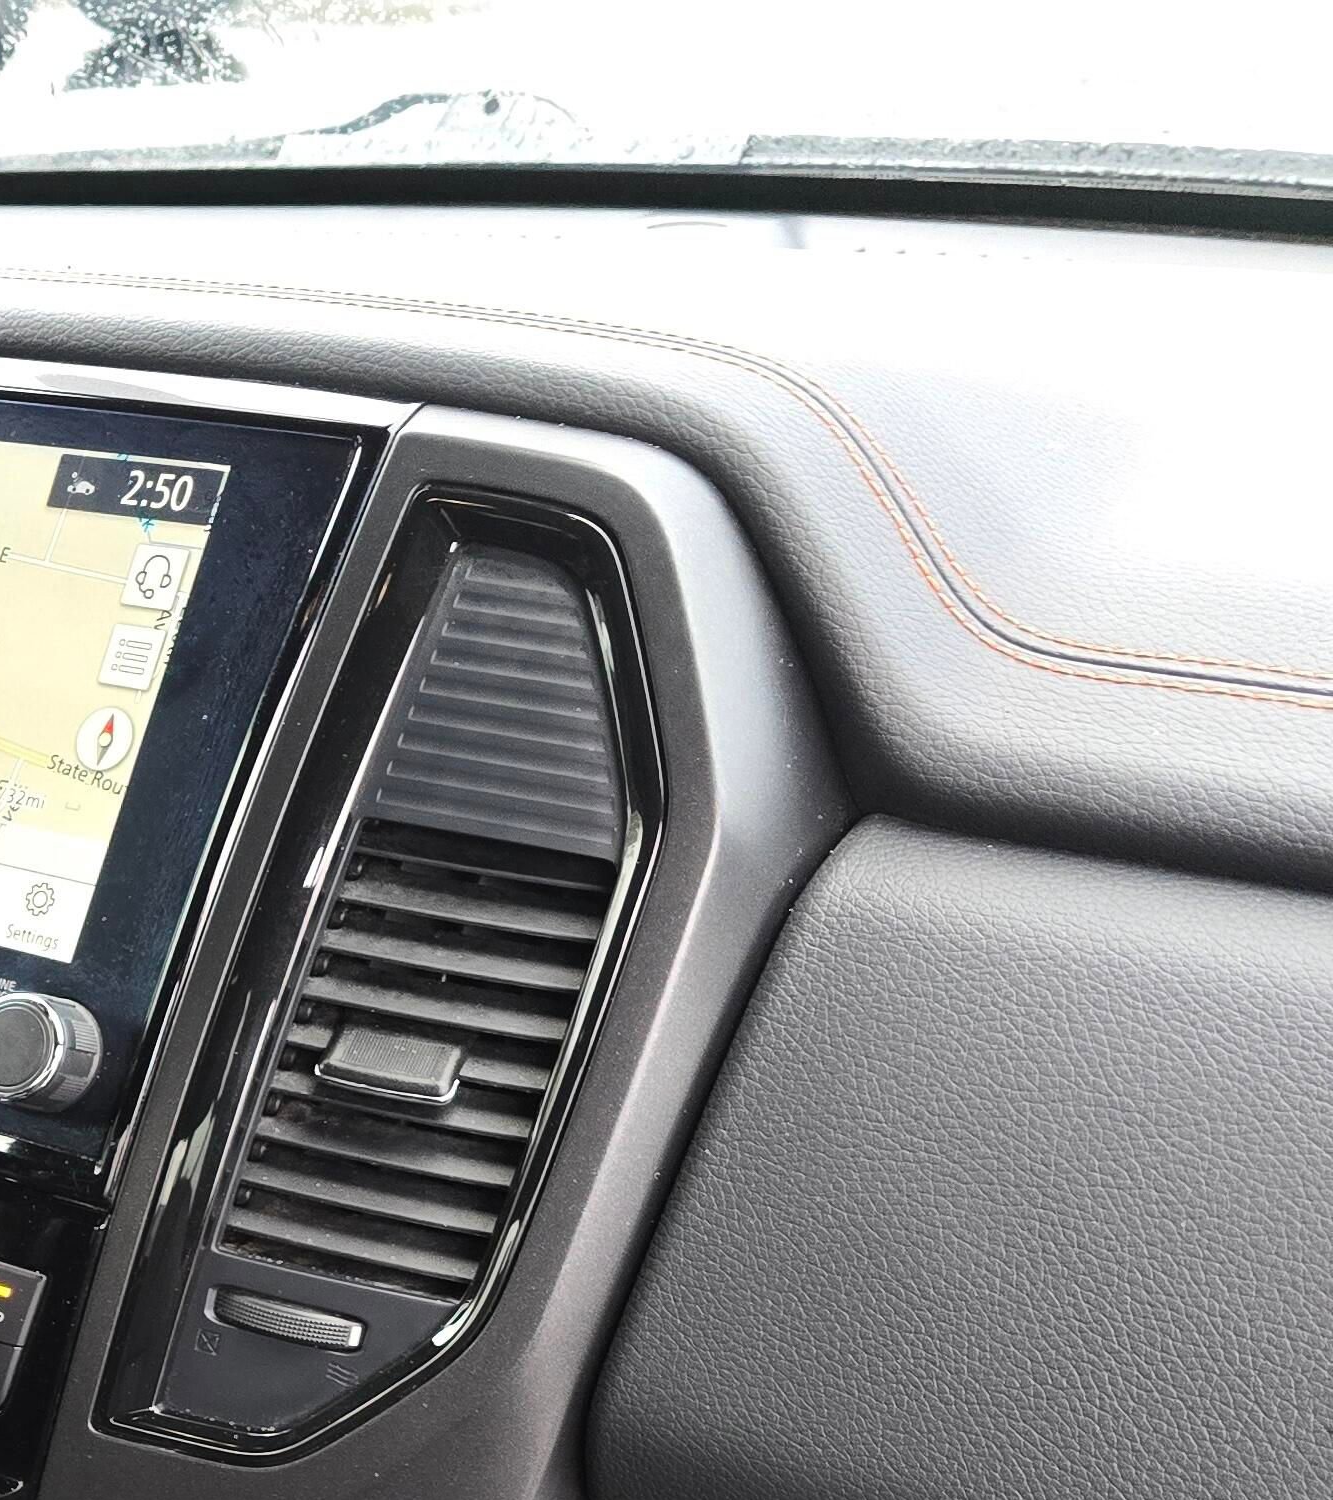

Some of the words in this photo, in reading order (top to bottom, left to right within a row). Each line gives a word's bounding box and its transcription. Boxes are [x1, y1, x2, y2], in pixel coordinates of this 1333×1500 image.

[120, 470, 194, 511] 2:50
[47, 754, 89, 782] State
[6, 923, 60, 951] Settings
